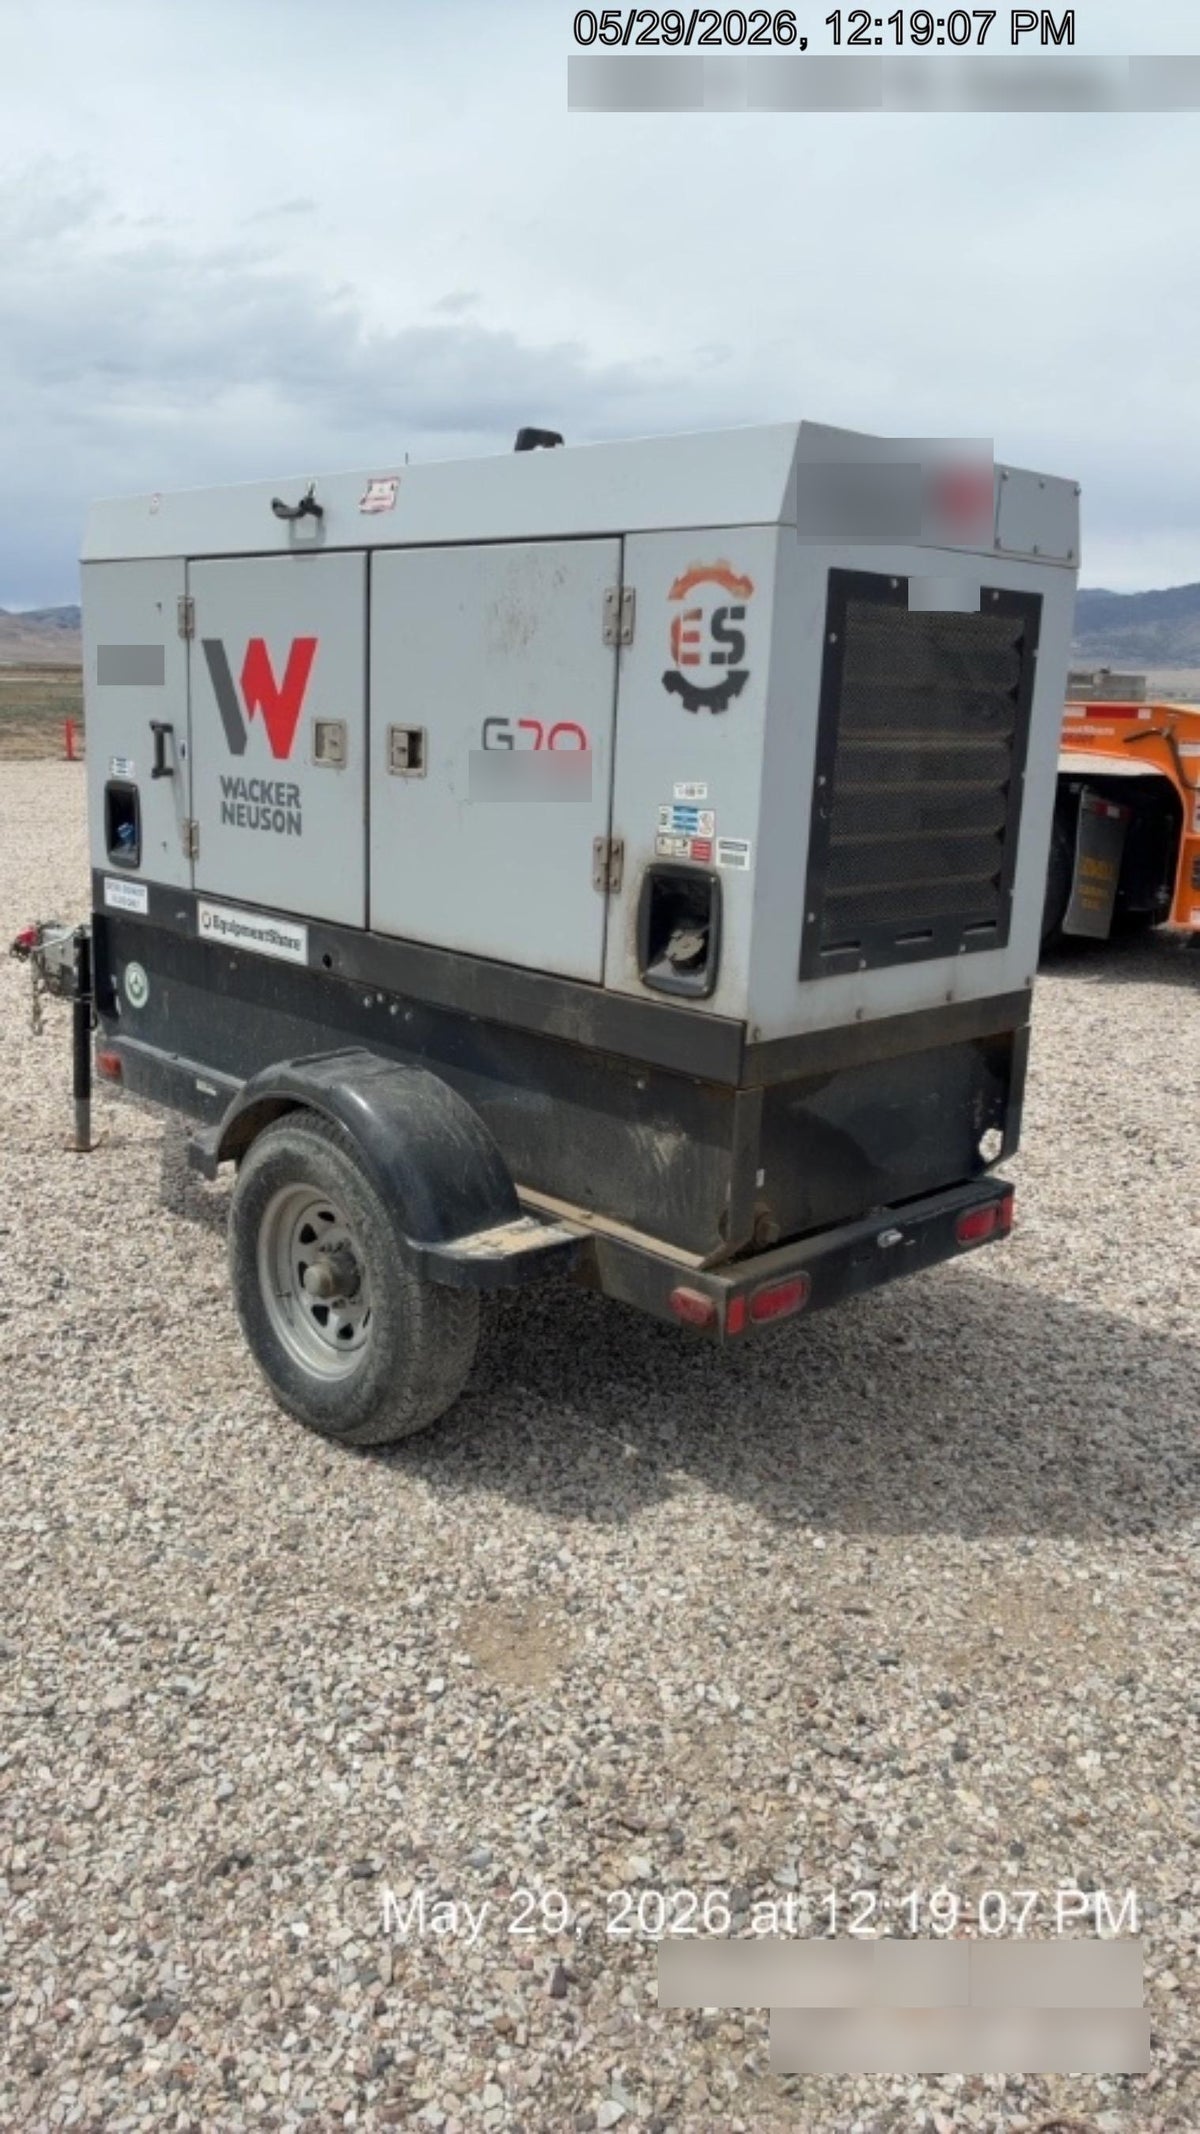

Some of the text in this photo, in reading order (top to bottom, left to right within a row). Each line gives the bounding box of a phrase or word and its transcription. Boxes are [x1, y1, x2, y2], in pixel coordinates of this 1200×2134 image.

[670, 606, 746, 667] ES
[219, 774, 302, 809] WACKER
[220, 801, 303, 837] NEUSON
